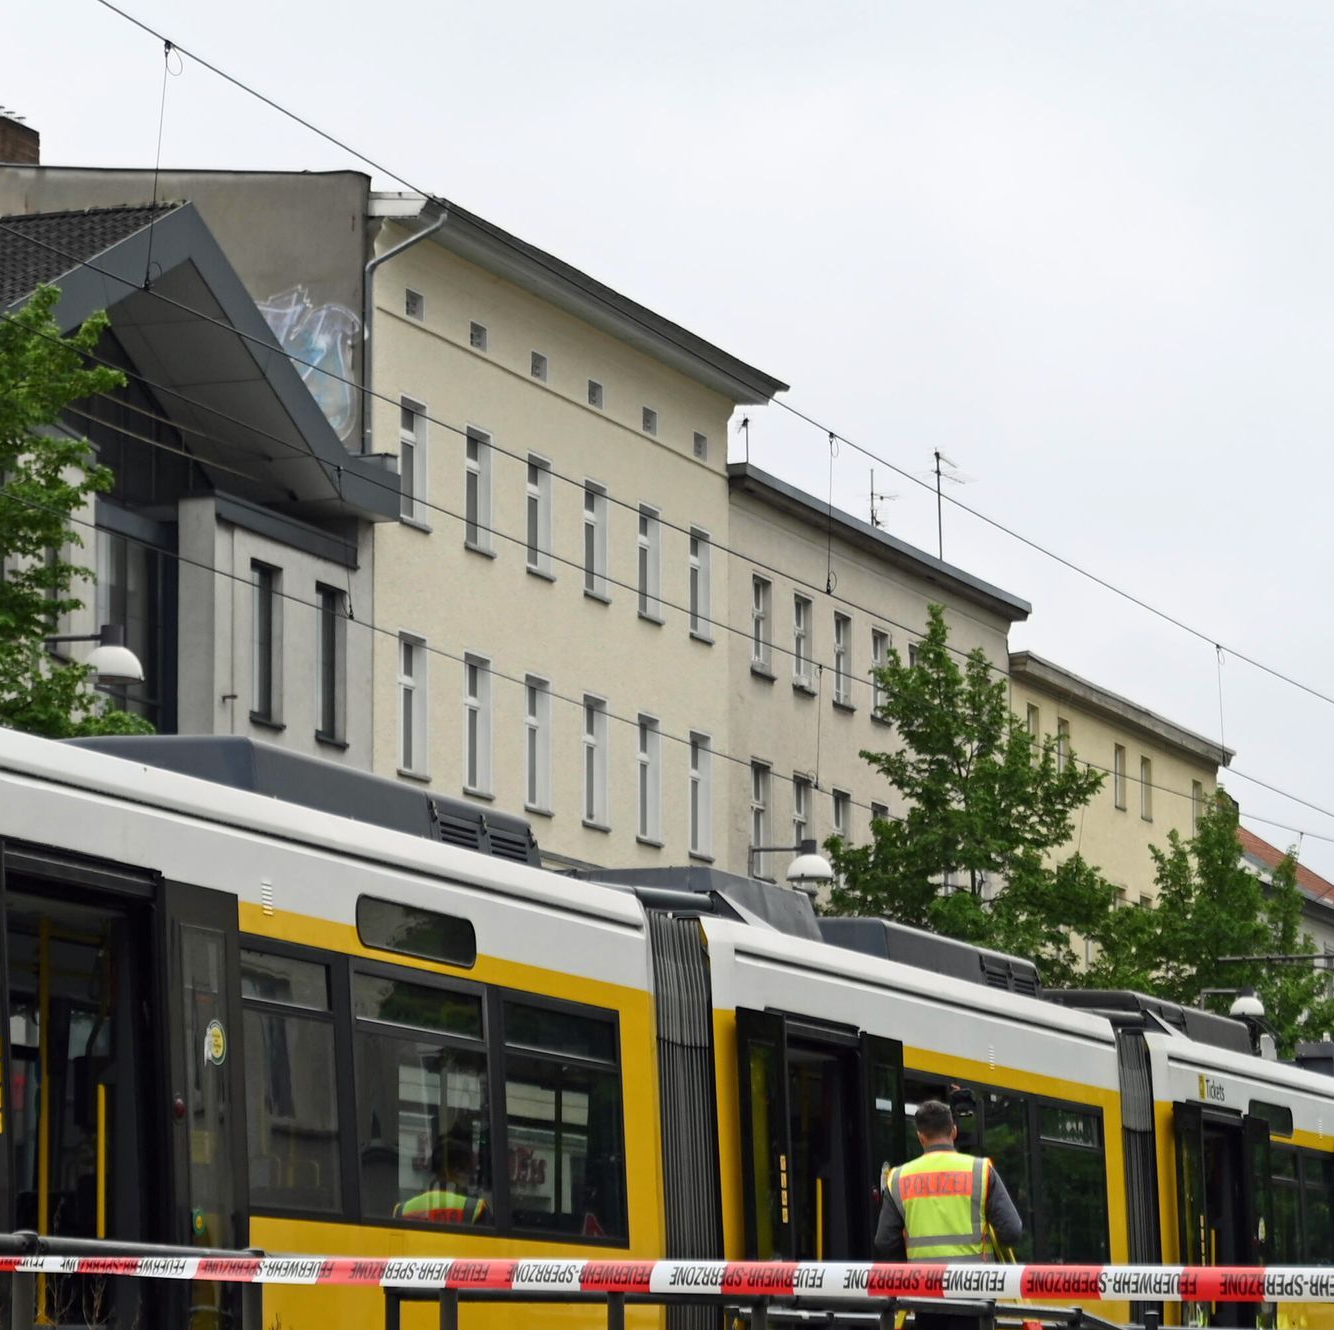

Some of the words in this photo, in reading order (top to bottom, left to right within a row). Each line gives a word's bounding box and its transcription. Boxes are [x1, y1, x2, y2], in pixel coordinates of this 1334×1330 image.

[1205, 1079, 1225, 1102] Tickets
[902, 1173, 968, 1195] POLIZEI
[505, 1262, 652, 1284] FEUERWEHR-SPERRZONE
[670, 1266, 824, 1289] FEUERWEHR-SPERRZONE
[843, 1268, 1005, 1293] FEUERWEHR-SPERRZONE
[1026, 1270, 1198, 1294] FEUERWEHR-SPERRZONE
